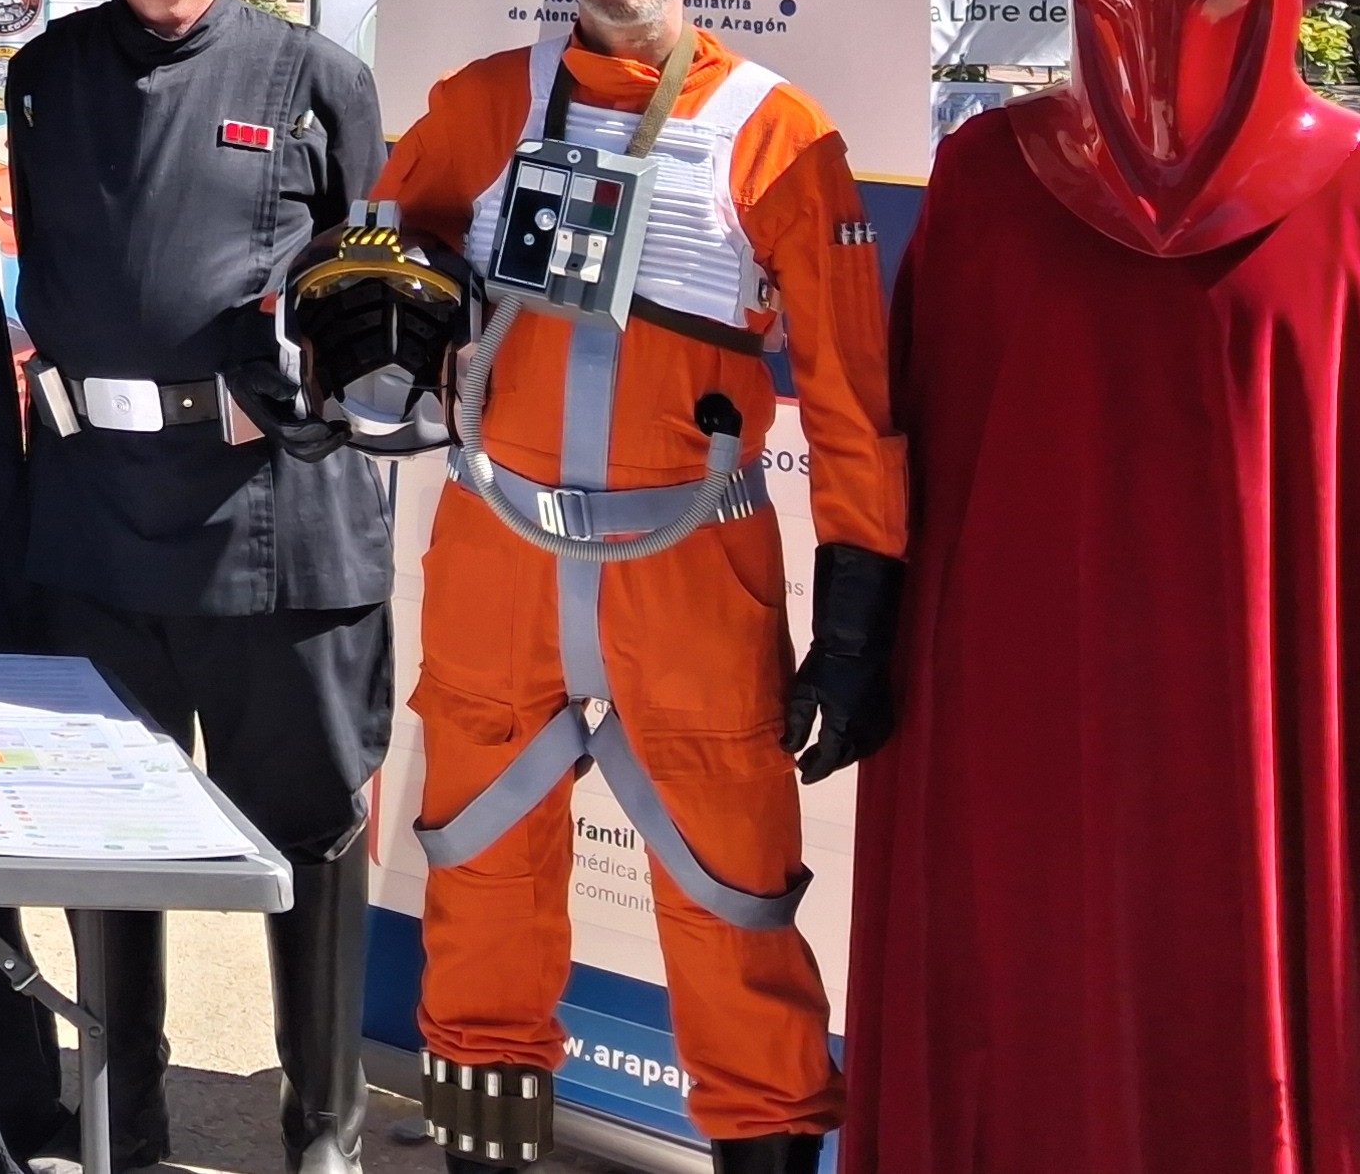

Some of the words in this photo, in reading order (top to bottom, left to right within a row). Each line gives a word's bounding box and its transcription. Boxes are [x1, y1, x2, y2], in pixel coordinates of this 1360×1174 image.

[508, 6, 528, 20] de
[533, 7, 579, 23] Atenc
[693, 14, 714, 29] de
[720, 15, 788, 35] Aragón
[576, 816, 636, 851] fantil
[574, 881, 656, 914] comunit
